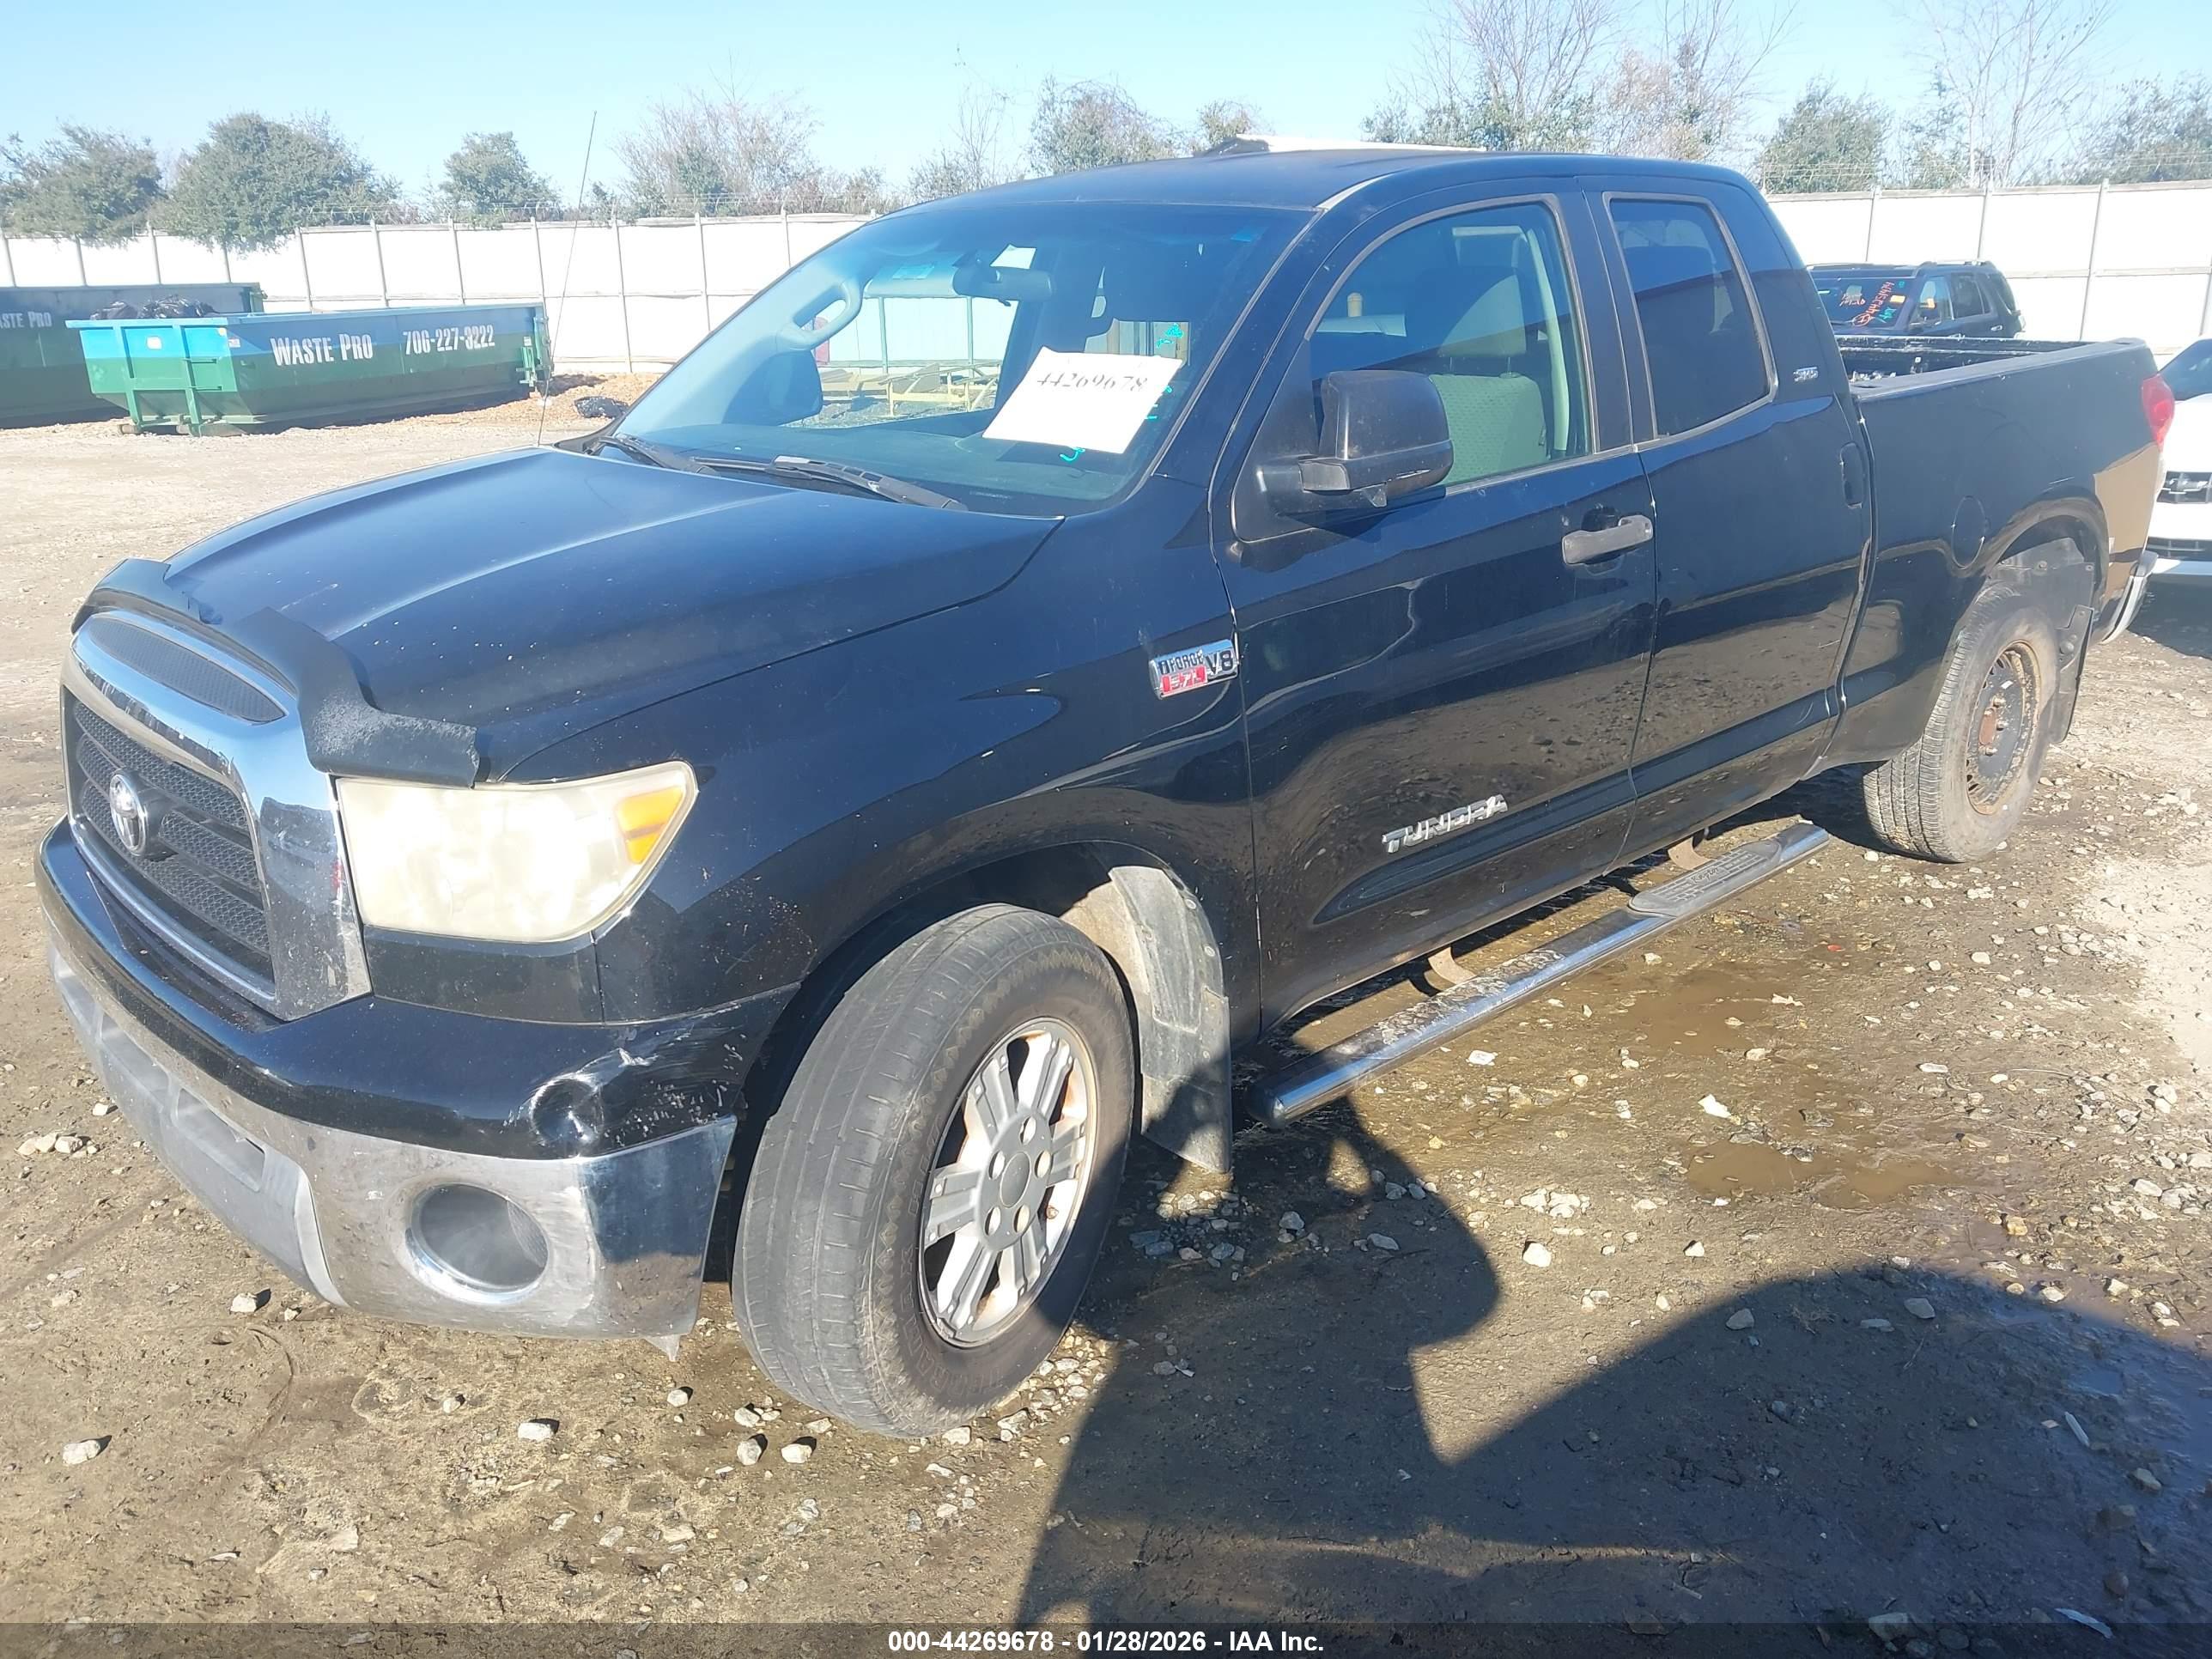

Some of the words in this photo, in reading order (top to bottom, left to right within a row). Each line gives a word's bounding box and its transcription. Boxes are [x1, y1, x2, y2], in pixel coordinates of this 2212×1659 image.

[0, 313, 24, 329] STE
[27, 311, 52, 328] PRO
[270, 337, 335, 366] WASTE
[339, 333, 374, 361] PRO
[403, 325, 495, 356] 706-227-3222
[1036, 372, 1148, 392] 44269678
[1205, 650, 1233, 675] V8
[1382, 793, 1509, 854] TUNDRA
